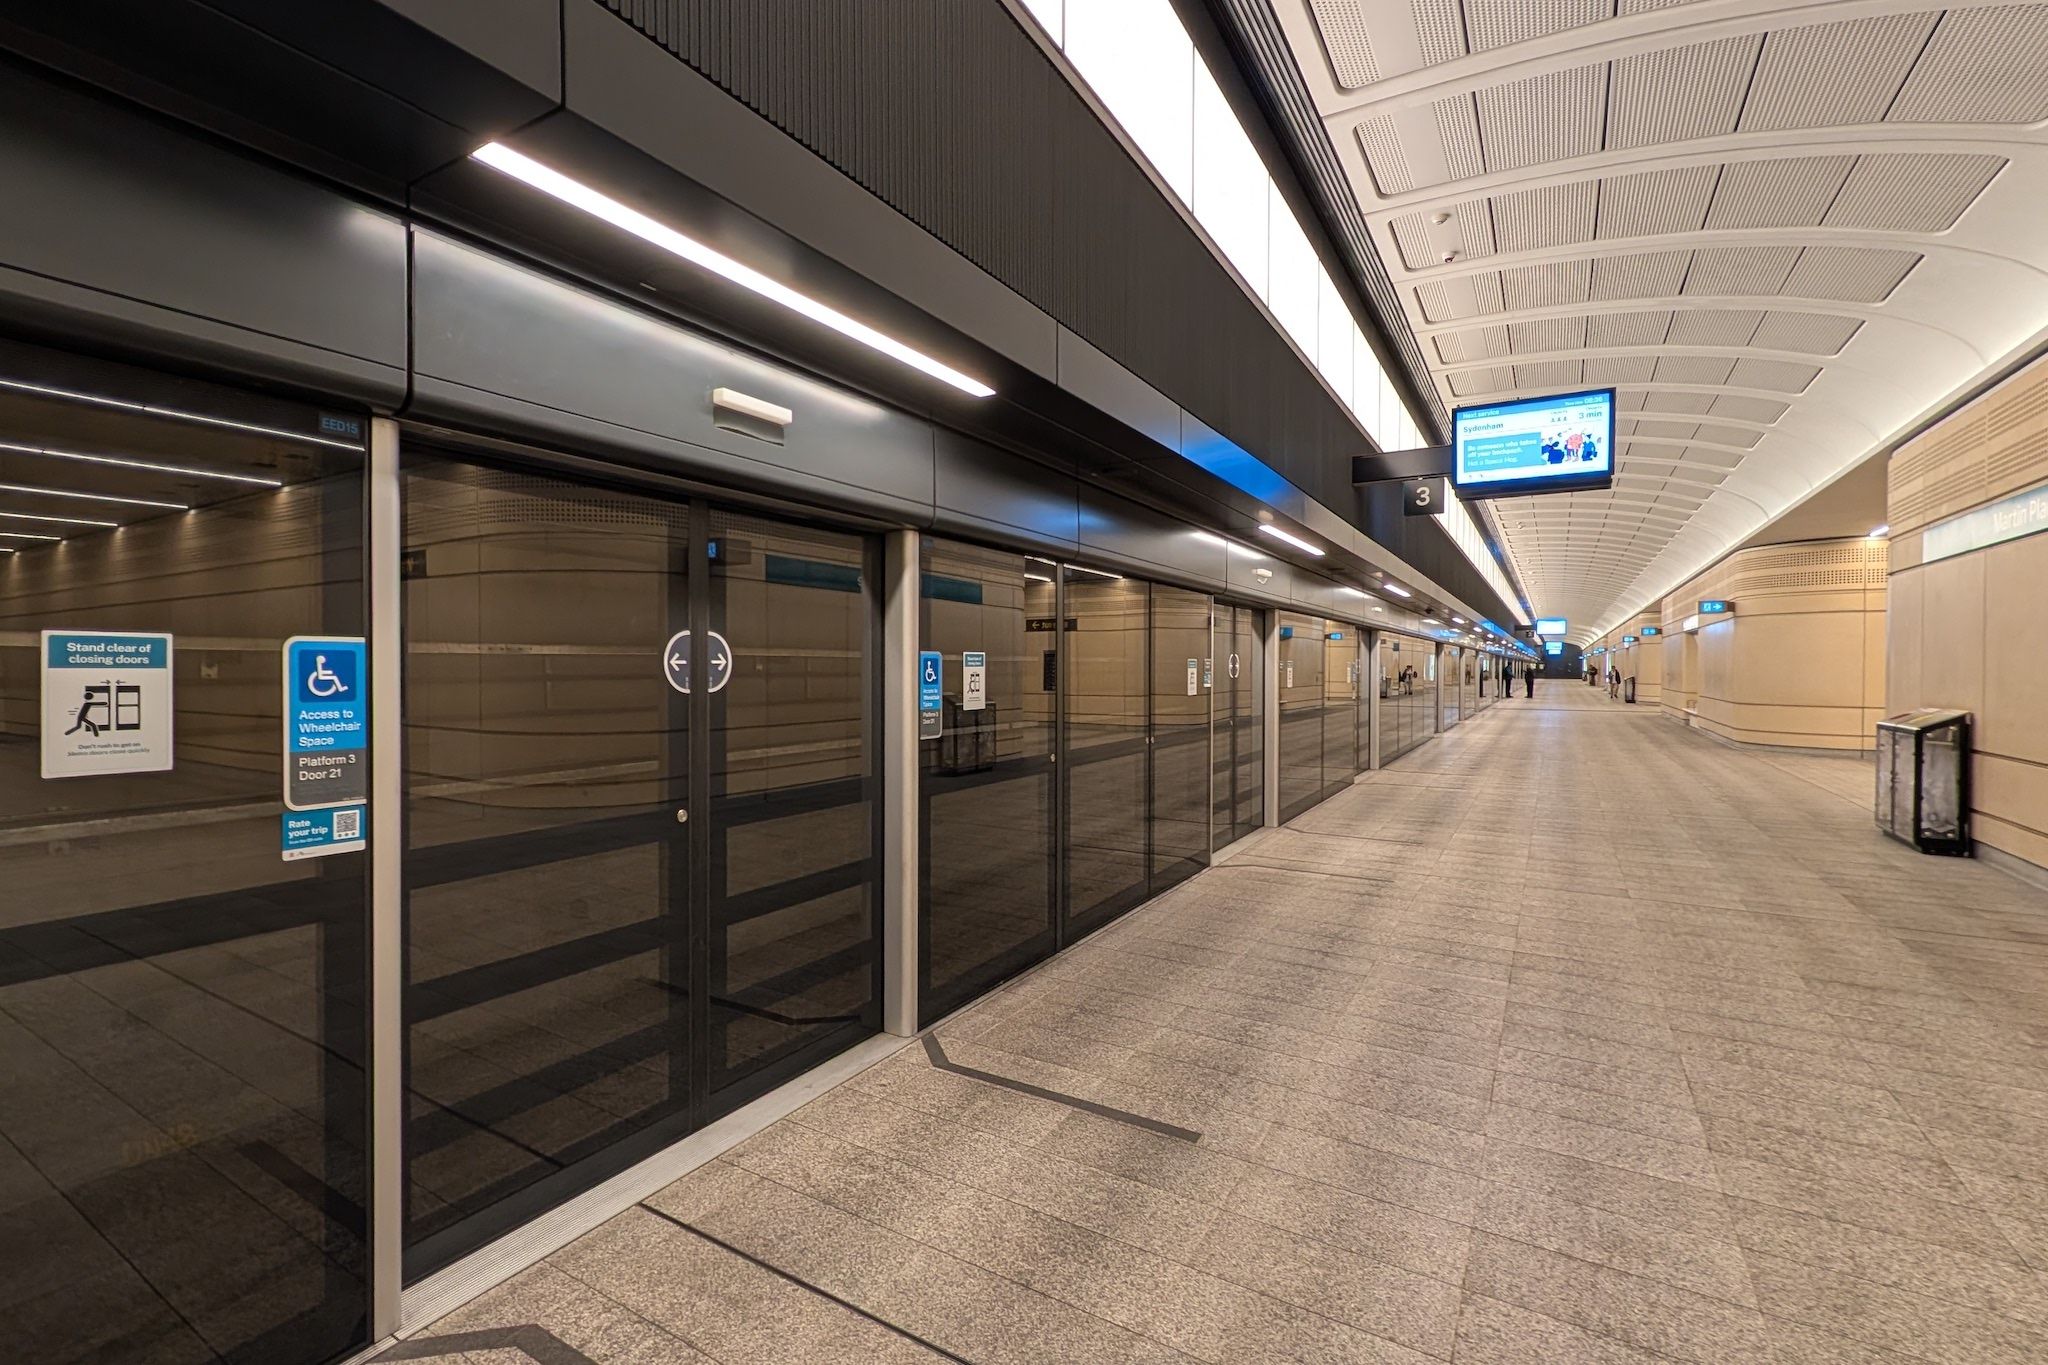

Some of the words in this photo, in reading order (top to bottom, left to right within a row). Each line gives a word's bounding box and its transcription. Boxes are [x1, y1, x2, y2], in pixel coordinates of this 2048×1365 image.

[1478, 409, 1500, 417] service
[1578, 412, 1584, 420] 3
[1586, 410, 1602, 418] min
[1463, 422, 1504, 433] Sydenham
[1415, 486, 1431, 507] 3
[66, 642, 105, 652] Stand
[107, 644, 137, 653] clear
[138, 644, 152, 653] of
[68, 655, 114, 665] closing
[115, 655, 150, 664] doors
[298, 710, 340, 720] Access
[342, 709, 354, 719] to
[298, 721, 362, 733] Wheelchair
[298, 736, 335, 748] Space
[298, 756, 347, 767] Platform
[348, 754, 356, 764] 3
[298, 770, 327, 781] Door
[329, 768, 342, 779] 21
[288, 820, 311, 829] Rate
[288, 830, 310, 839] your
[311, 826, 329, 836] trip
